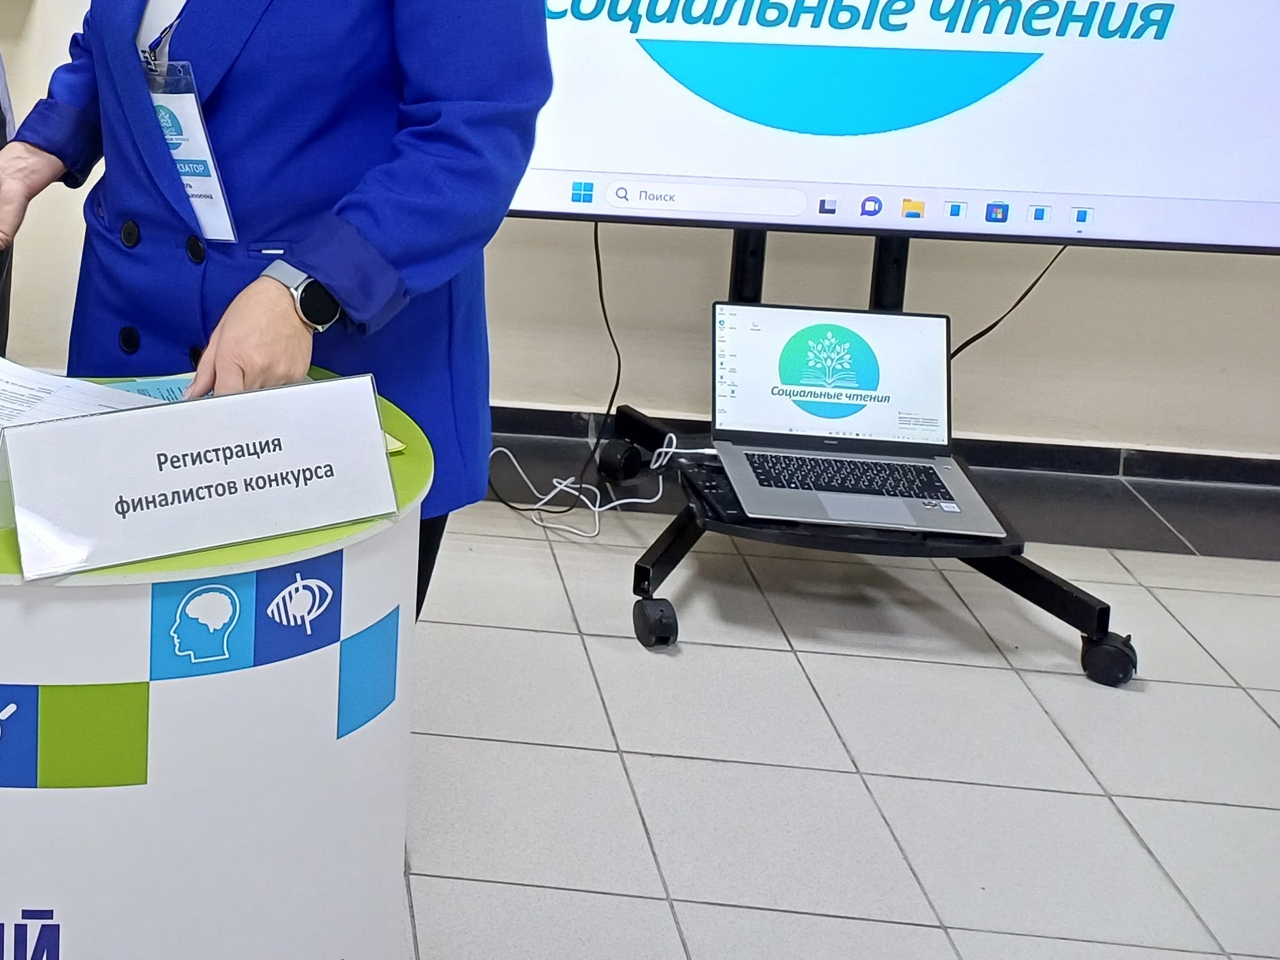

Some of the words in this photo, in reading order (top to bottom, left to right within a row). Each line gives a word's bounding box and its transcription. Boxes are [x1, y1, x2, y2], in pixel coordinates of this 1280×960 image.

[639, 190, 676, 202] Поиск
[770, 385, 843, 401] Социальные
[845, 392, 891, 404] чтения
[156, 435, 283, 472] Регистрация
[114, 480, 239, 519] финалистов
[243, 460, 335, 493] конкурса
